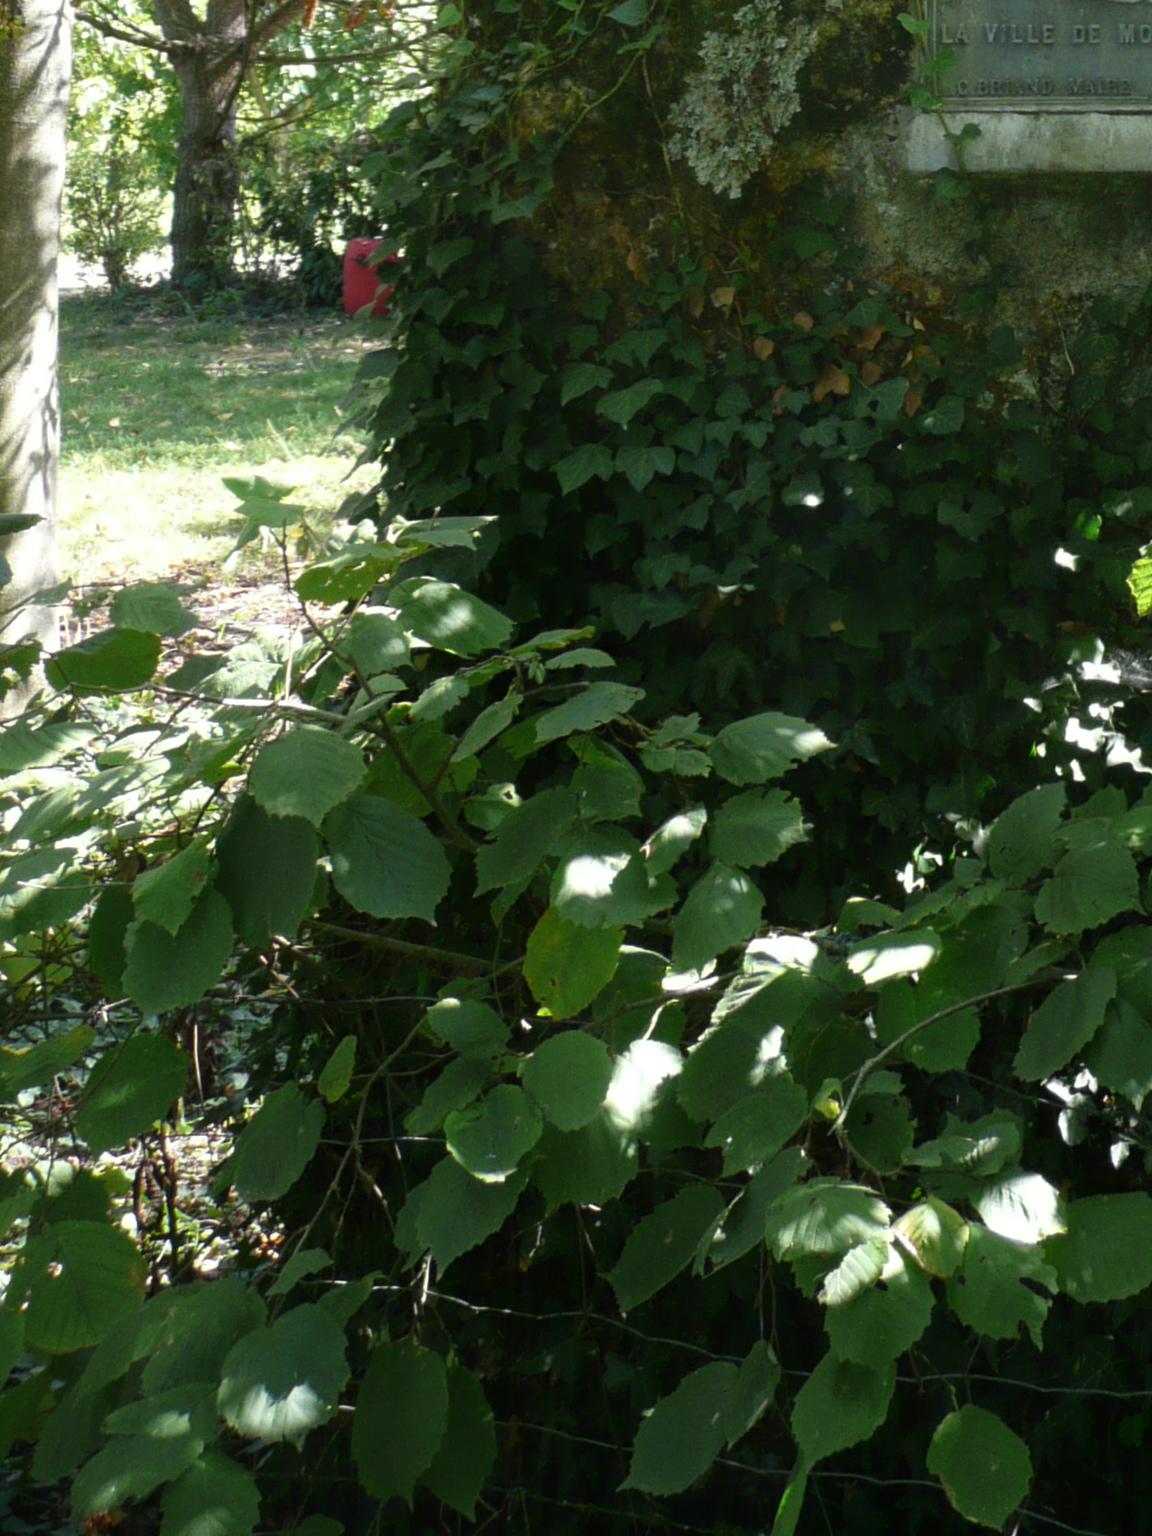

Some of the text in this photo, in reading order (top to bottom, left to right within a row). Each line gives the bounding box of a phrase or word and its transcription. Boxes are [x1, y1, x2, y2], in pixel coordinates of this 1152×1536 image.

[940, 23, 969, 44] LA
[984, 23, 1055, 44] VILLE
[1072, 24, 1101, 44] DE
